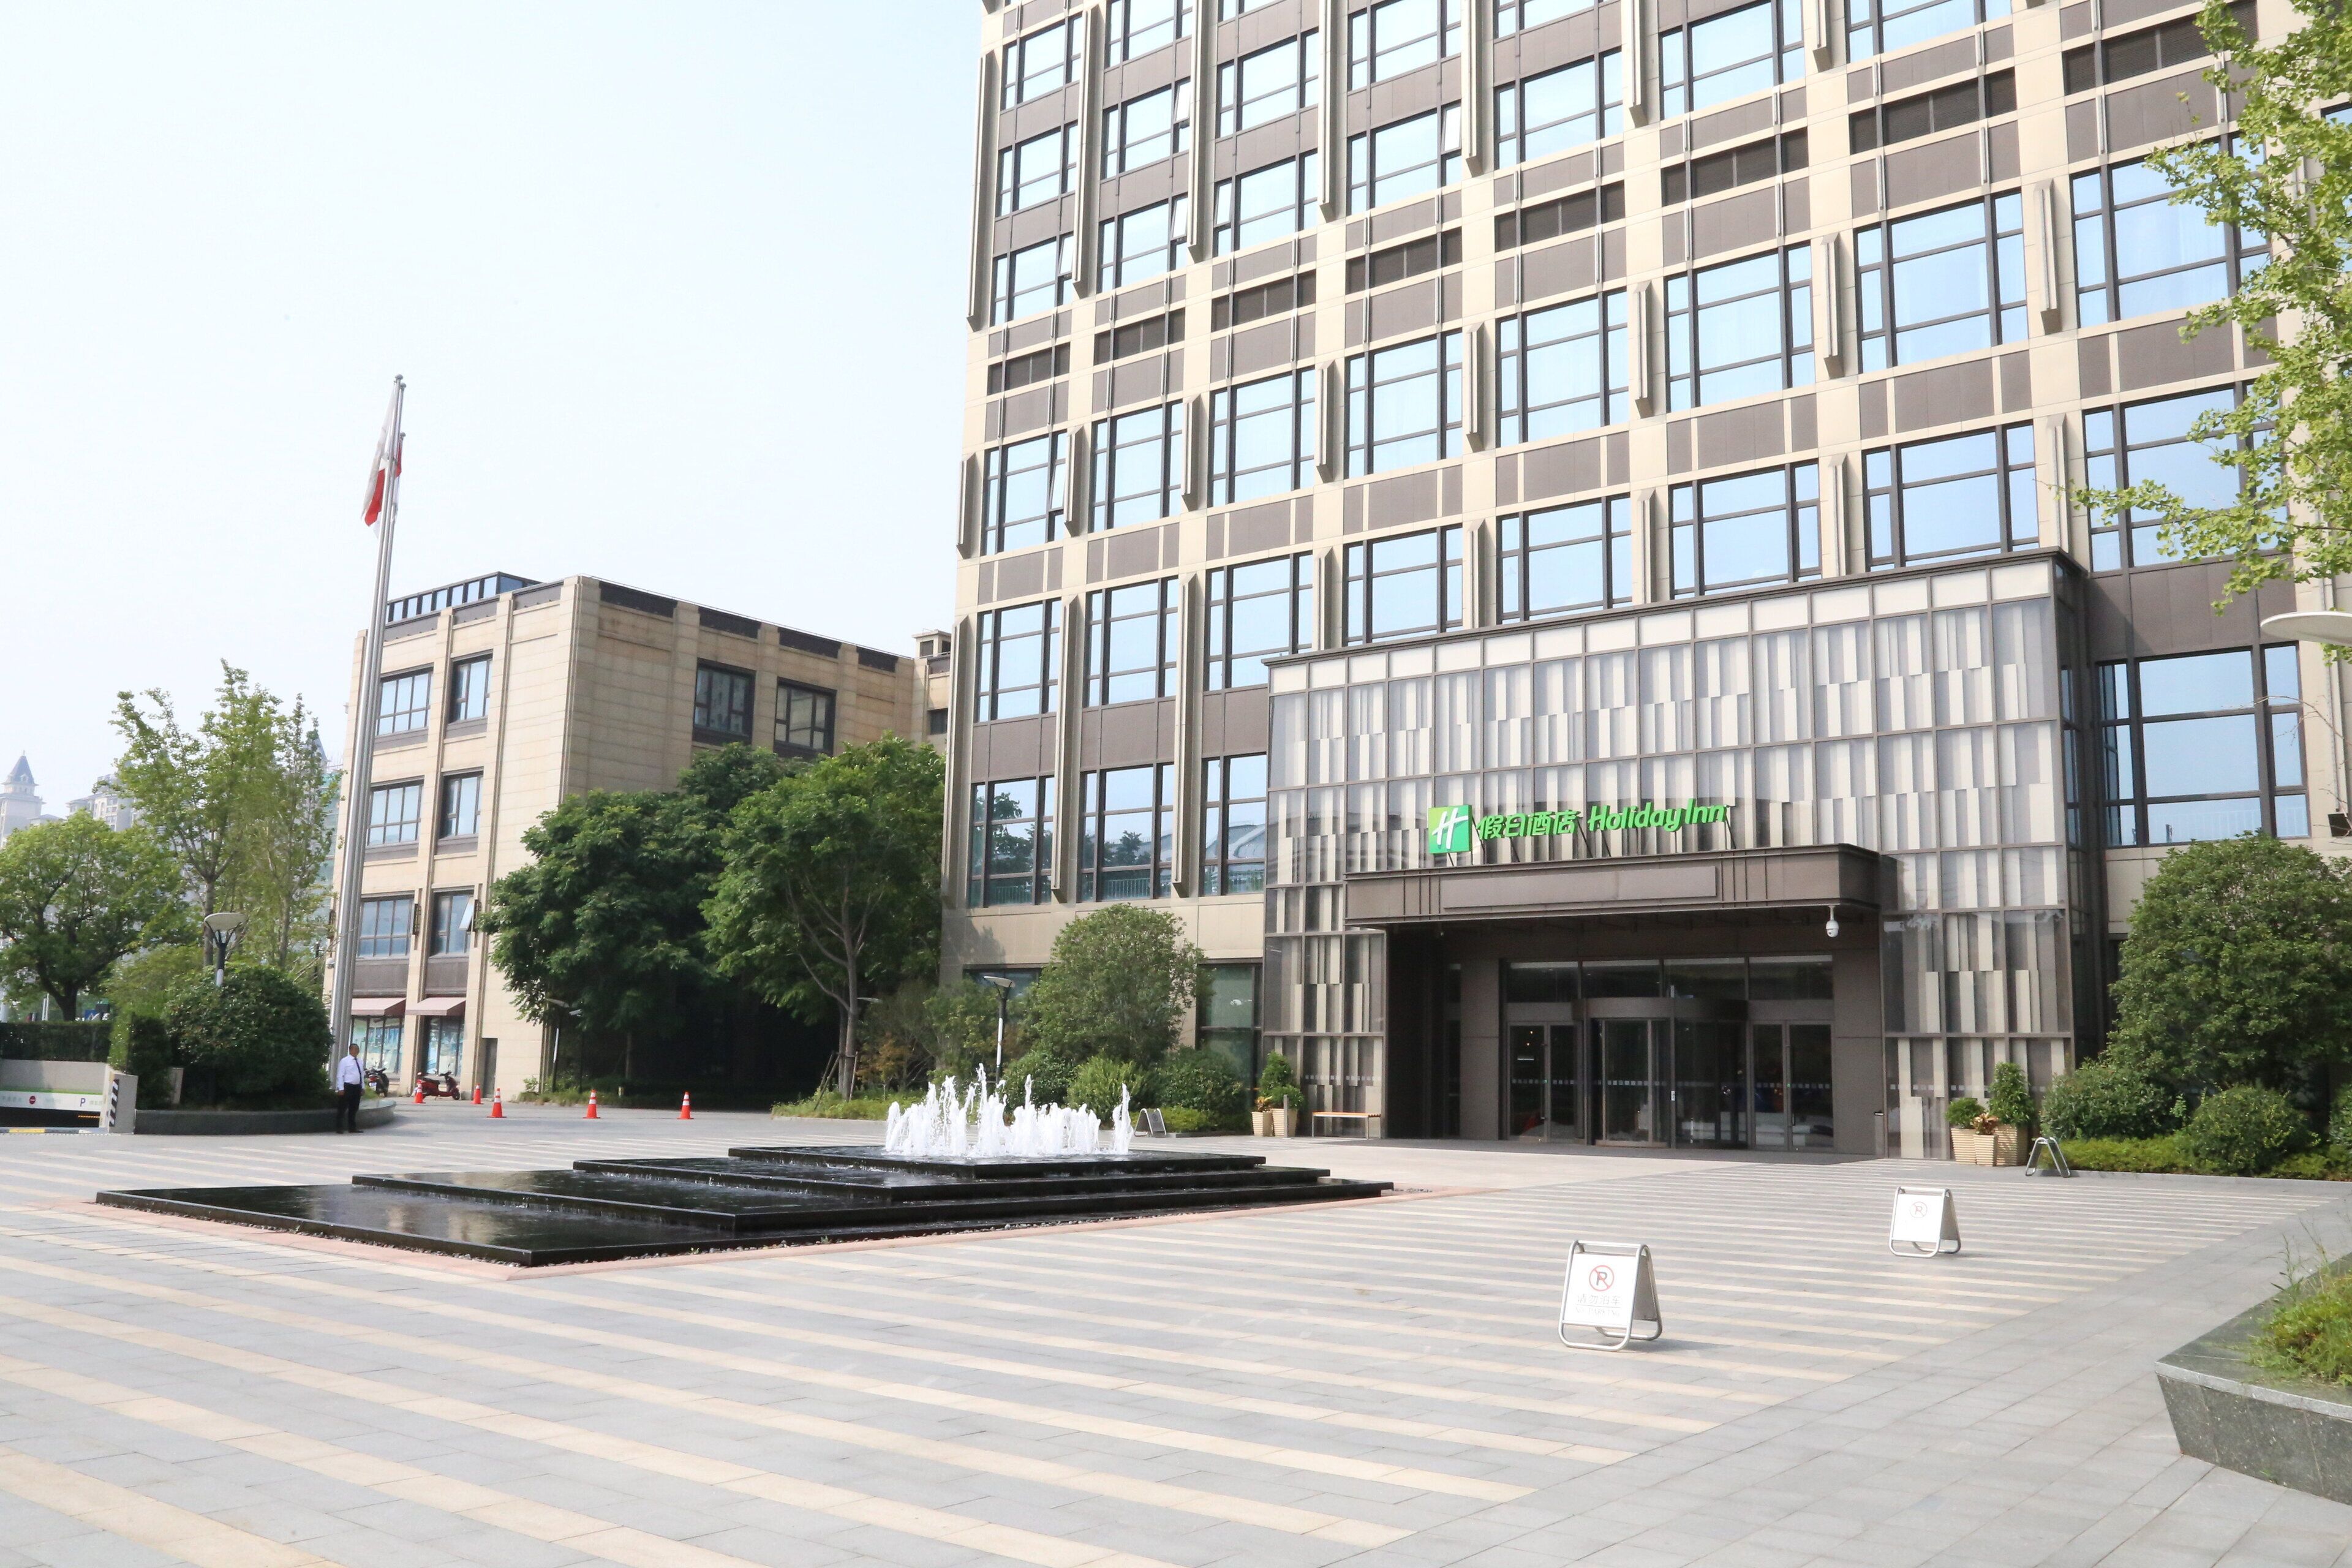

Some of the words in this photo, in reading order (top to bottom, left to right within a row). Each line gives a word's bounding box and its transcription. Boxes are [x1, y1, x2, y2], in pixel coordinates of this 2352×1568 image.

[1476, 810, 1580, 840] 假日酒店
[1588, 802, 1686, 832] Holiday
[1685, 799, 1727, 824] Inn
[80, 1098, 86, 1107] P
